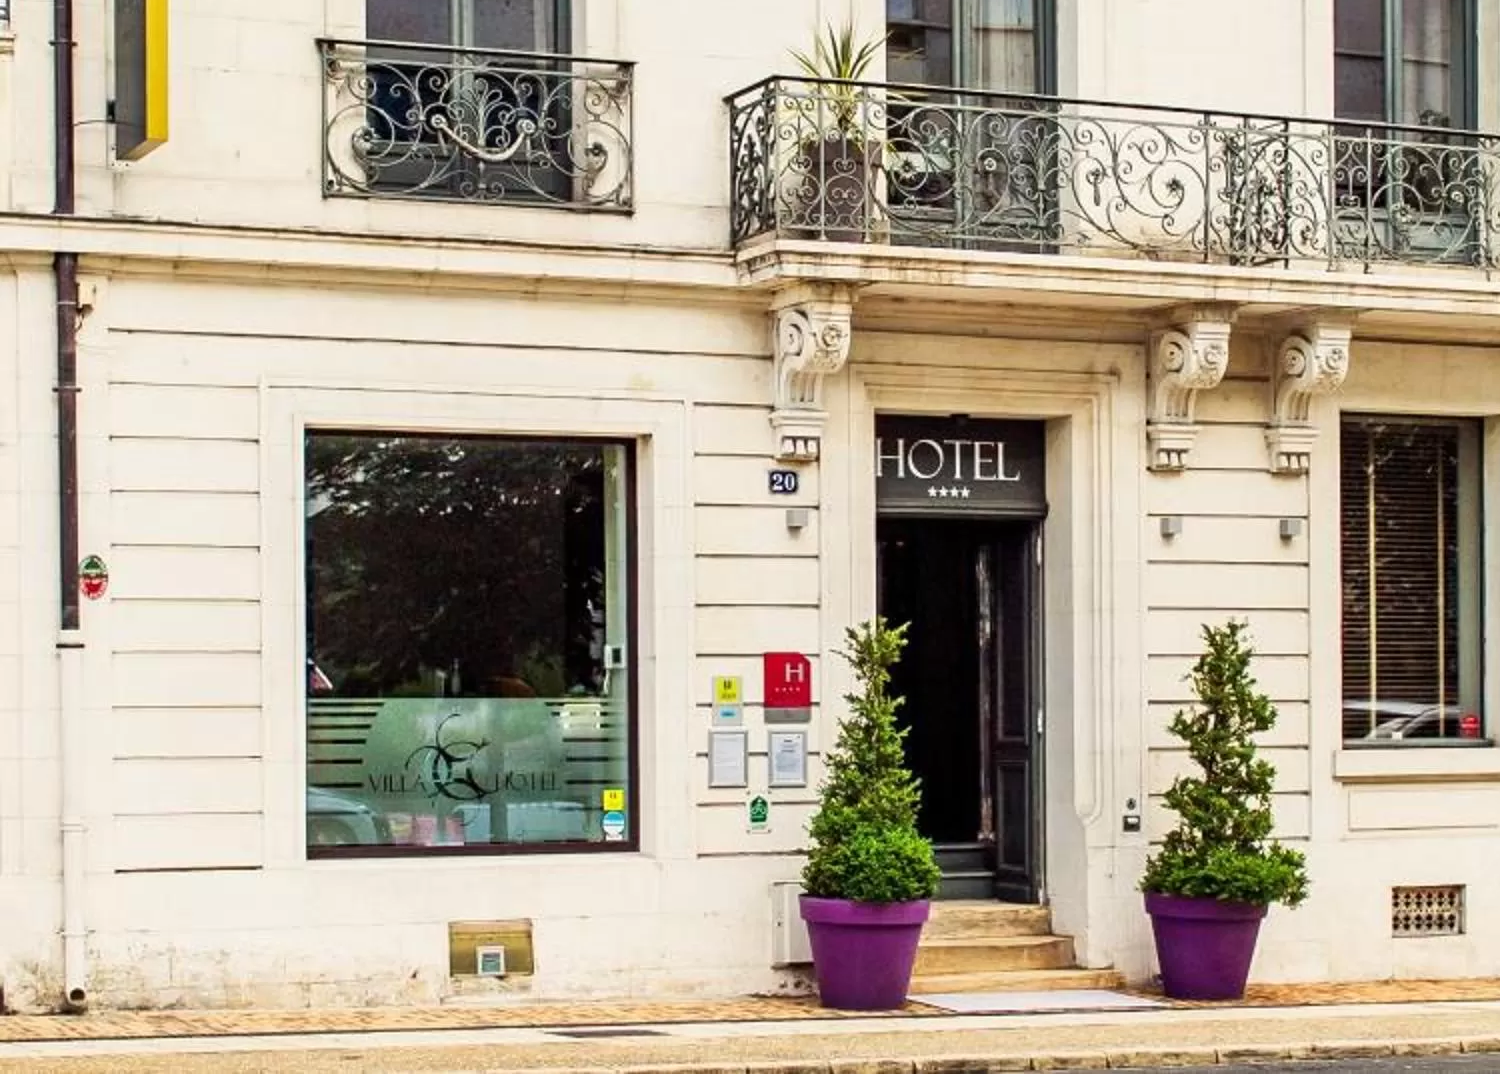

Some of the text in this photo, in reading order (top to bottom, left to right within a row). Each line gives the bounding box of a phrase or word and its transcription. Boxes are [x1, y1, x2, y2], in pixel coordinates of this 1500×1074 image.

[876, 438, 1020, 481] HOTEL
[772, 473, 796, 491] 20
[785, 662, 804, 683] H
[368, 773, 426, 793] VILLA
